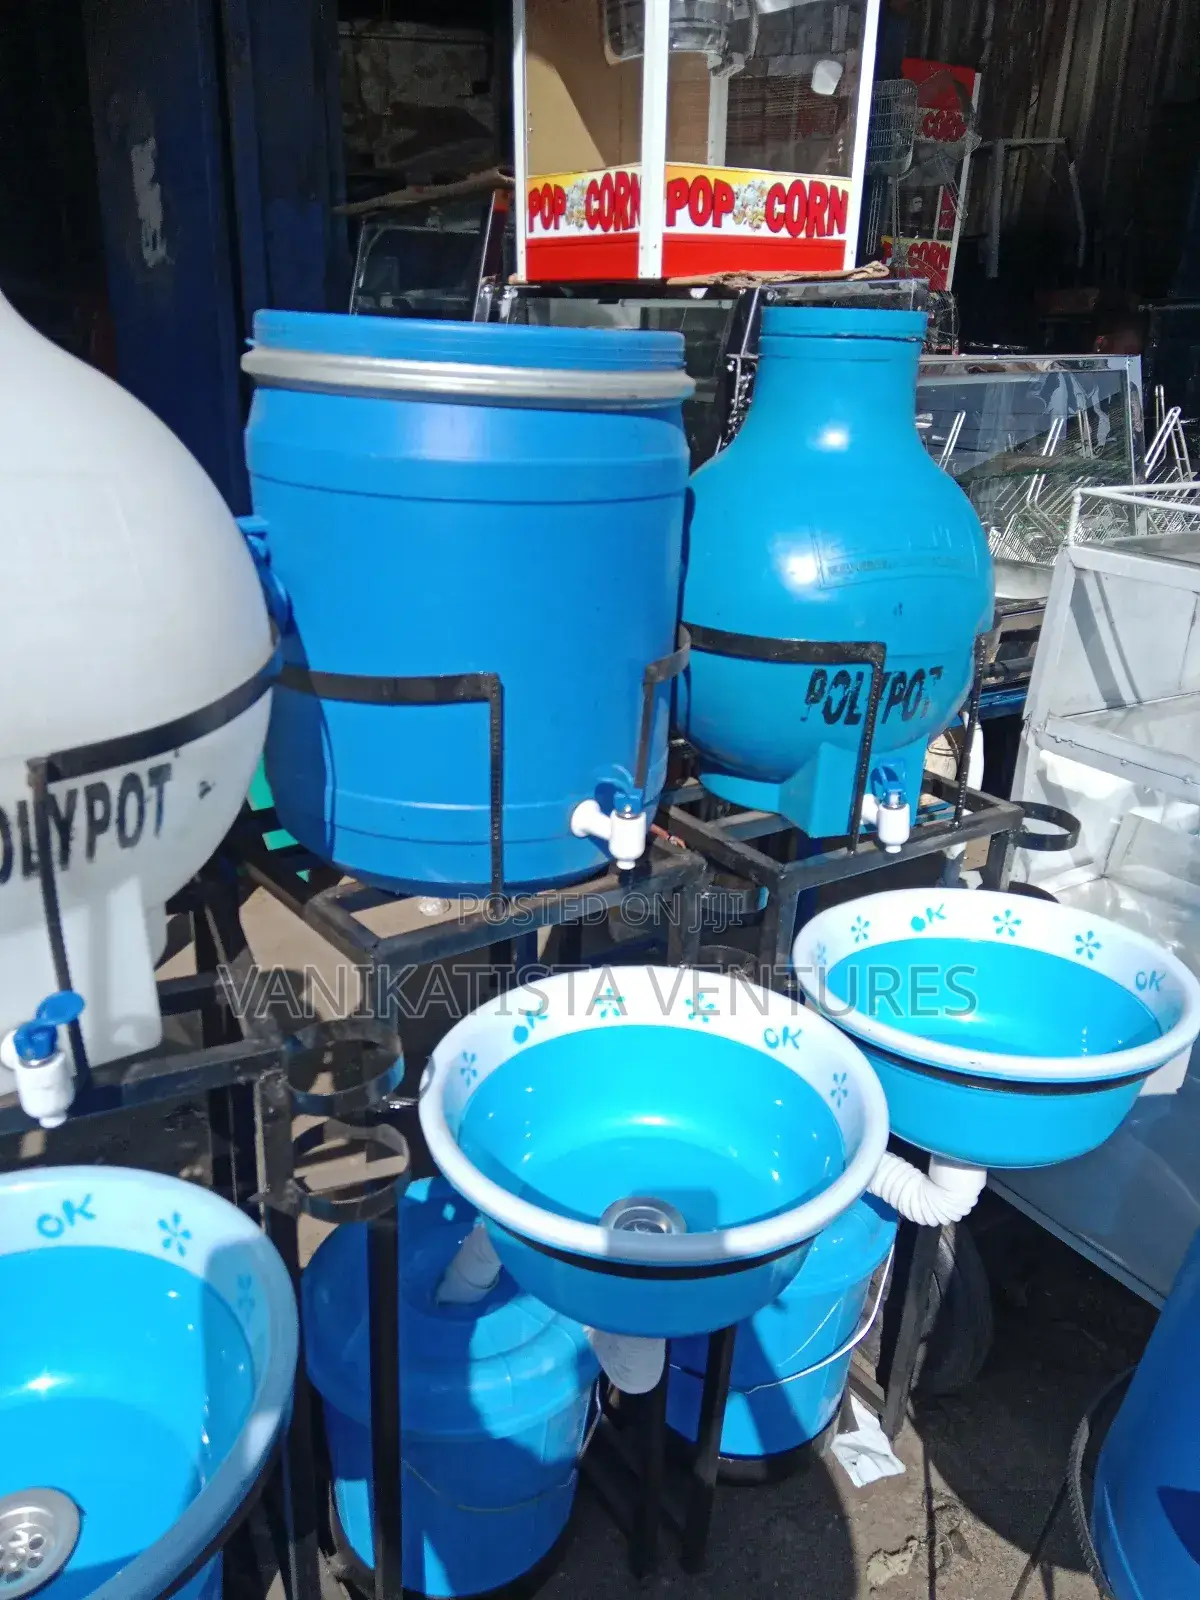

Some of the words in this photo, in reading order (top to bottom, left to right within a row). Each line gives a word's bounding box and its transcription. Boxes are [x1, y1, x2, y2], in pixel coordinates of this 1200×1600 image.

[528, 183, 566, 233] POP
[666, 175, 735, 228] POP
[765, 179, 849, 238] CORN
[1136, 970, 1167, 992] OK
[764, 1026, 802, 1050] OK
[37, 1193, 97, 1238] OK
